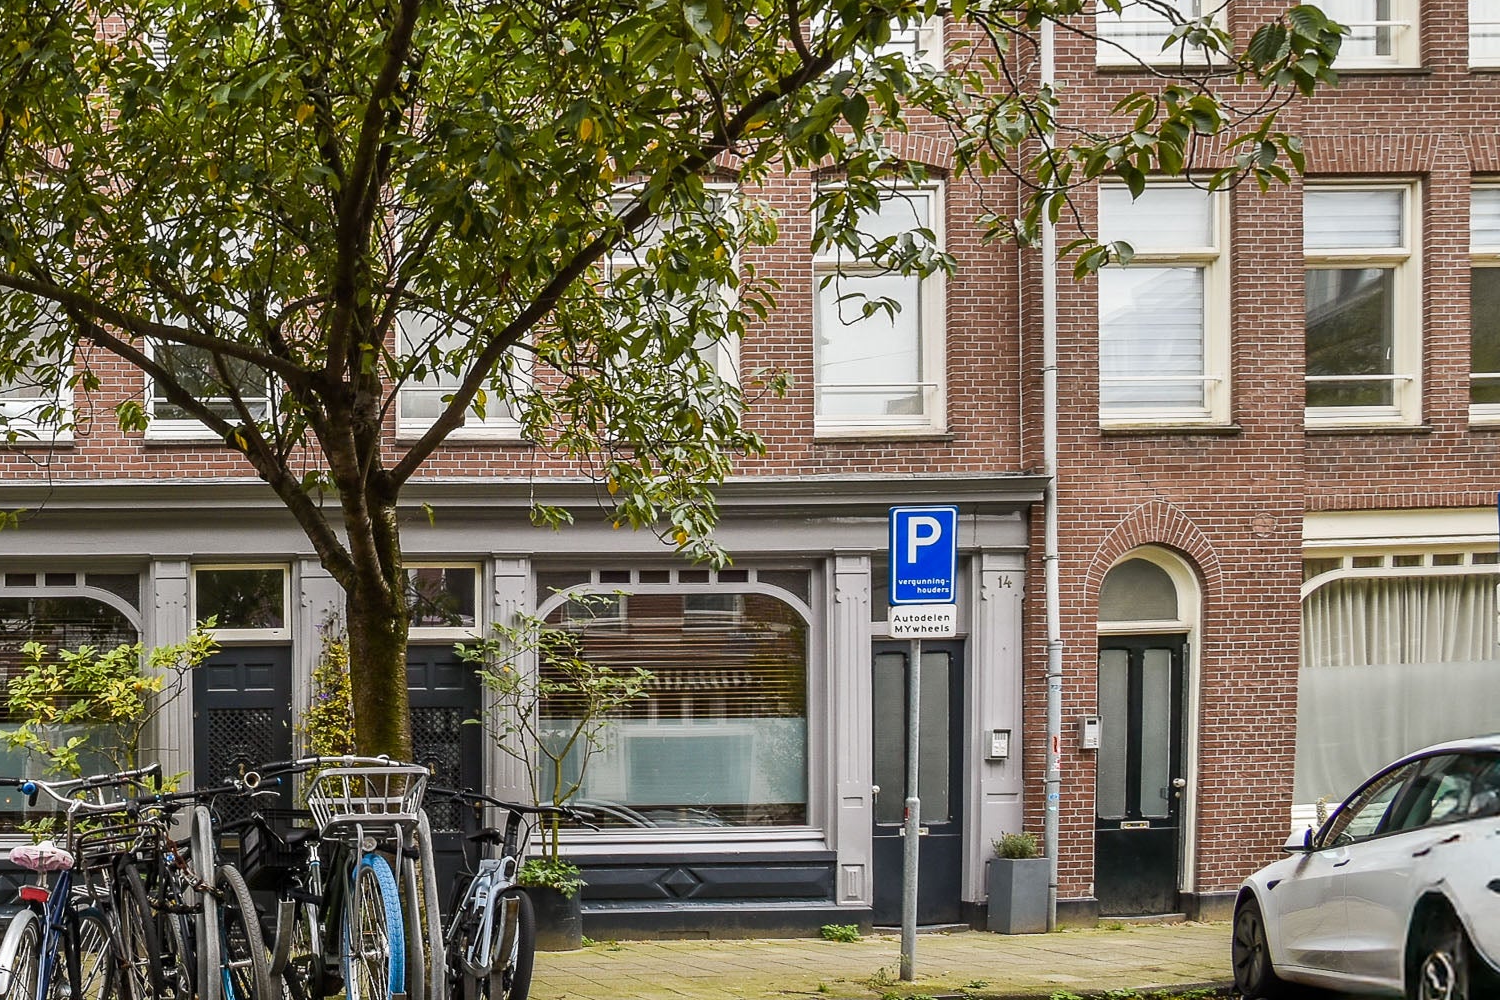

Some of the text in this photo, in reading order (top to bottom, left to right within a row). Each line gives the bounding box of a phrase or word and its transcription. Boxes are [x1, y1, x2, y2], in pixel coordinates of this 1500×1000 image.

[907, 516, 942, 564] P
[898, 577, 950, 587] vergunning-
[997, 575, 1013, 589] 14
[916, 586, 950, 594] houders
[893, 613, 950, 622] Autodelen
[894, 624, 950, 633] MYwheels
